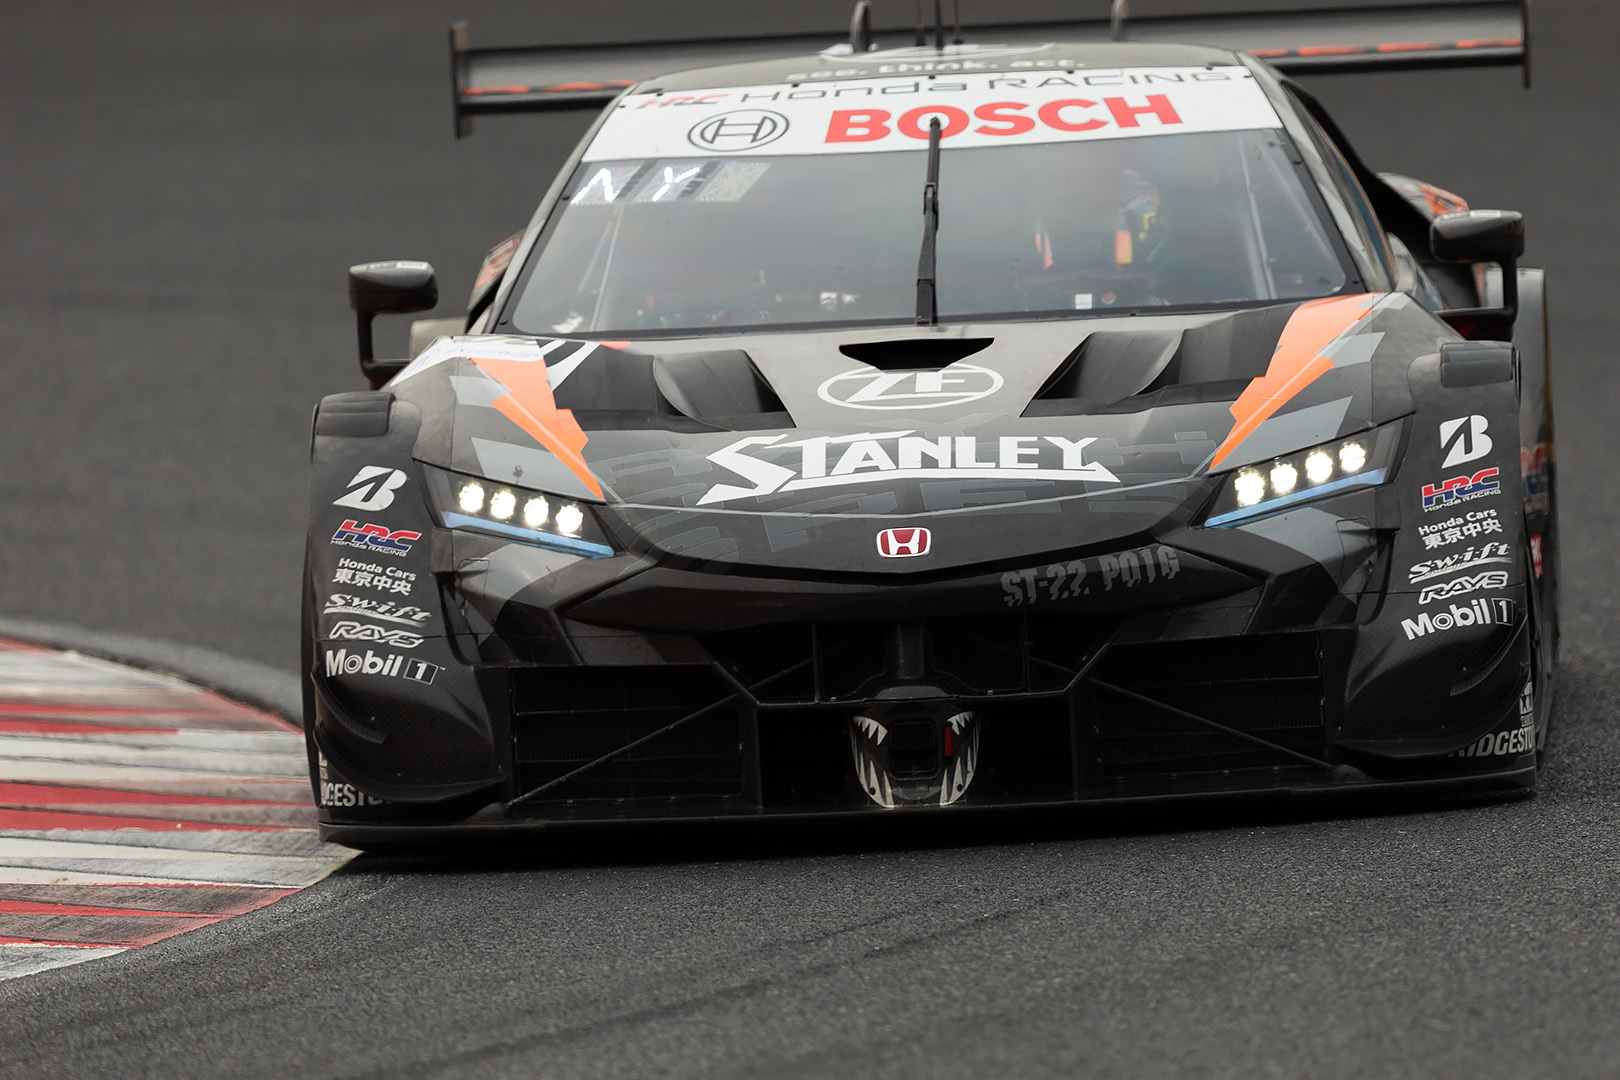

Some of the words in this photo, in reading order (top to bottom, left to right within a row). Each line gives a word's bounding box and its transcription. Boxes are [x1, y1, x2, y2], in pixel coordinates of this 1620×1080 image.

[878, 59, 998, 75] think.
[741, 81, 967, 103] Honda
[989, 72, 1232, 90] RACING
[824, 94, 1183, 143] BOSCH
[837, 370, 989, 402] ZF
[696, 430, 1120, 505] STANLEY
[1421, 467, 1499, 508] HRC
[331, 519, 422, 553] HRC
[1418, 516, 1464, 536] Honda
[1466, 508, 1497, 522] Cars
[1422, 518, 1503, 550] 東京中央
[367, 545, 408, 557] RACING
[1408, 542, 1511, 581] Swift
[332, 568, 412, 596] 東京中央
[338, 557, 383, 574] Honda
[385, 566, 417, 581] Cars
[1419, 570, 1509, 605] RAYS
[324, 593, 432, 624] Swift
[1401, 598, 1491, 640] Mobil
[329, 621, 424, 649] RAYS
[325, 649, 404, 678] Mobil
